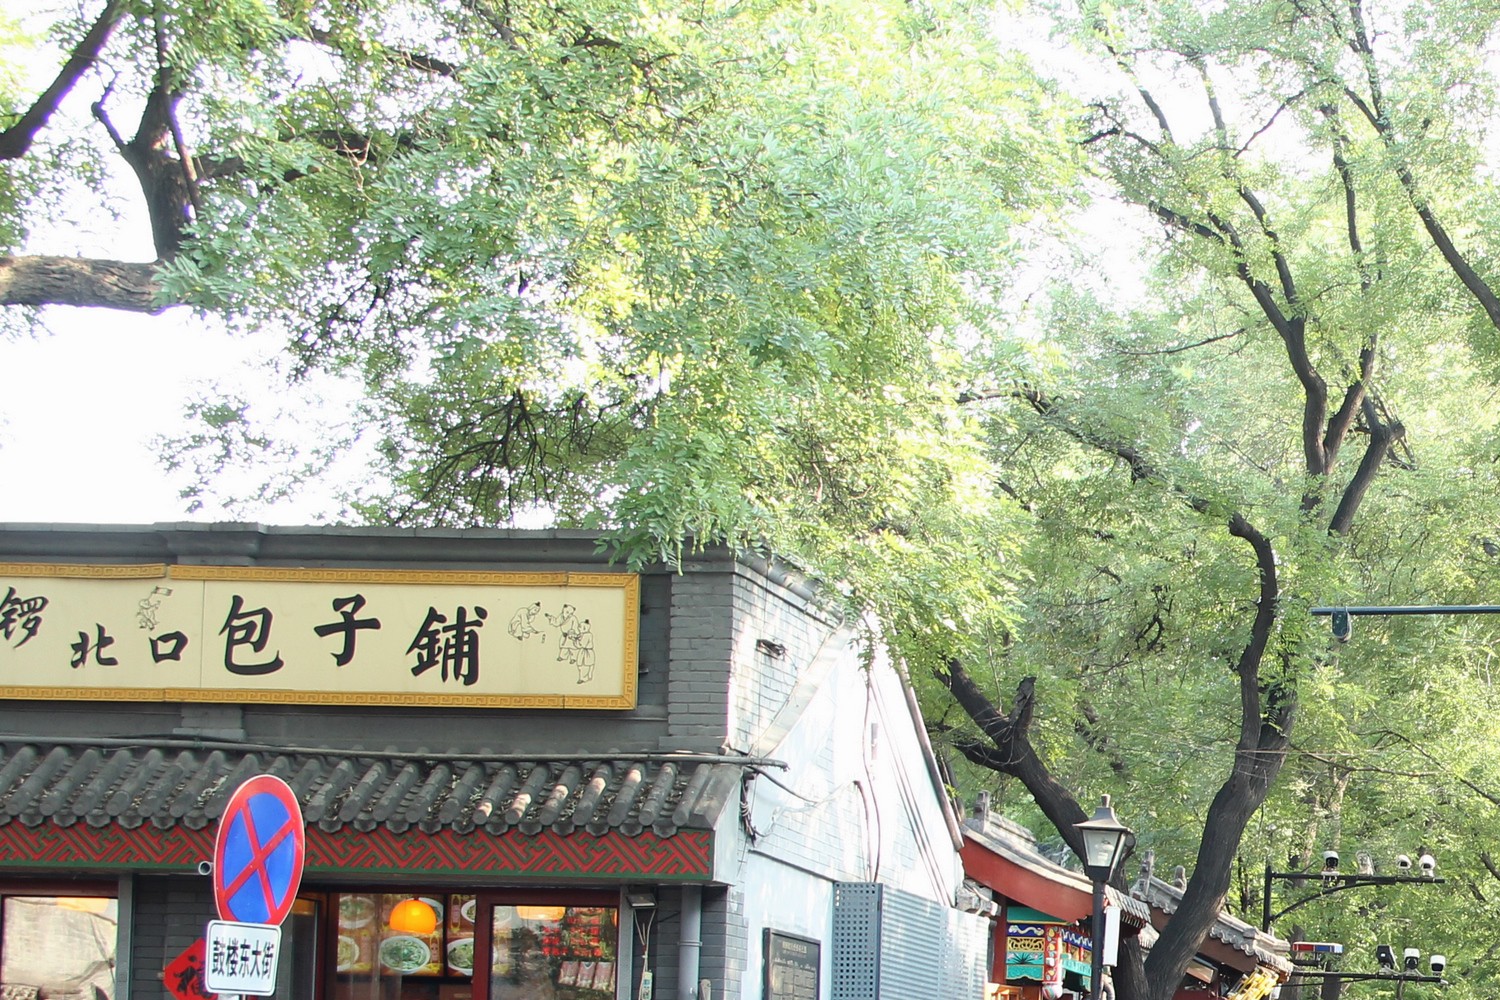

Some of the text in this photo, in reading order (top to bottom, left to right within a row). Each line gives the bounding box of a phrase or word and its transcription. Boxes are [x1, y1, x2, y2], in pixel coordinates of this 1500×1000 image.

[211, 937, 275, 980] 鼓楼东大街
